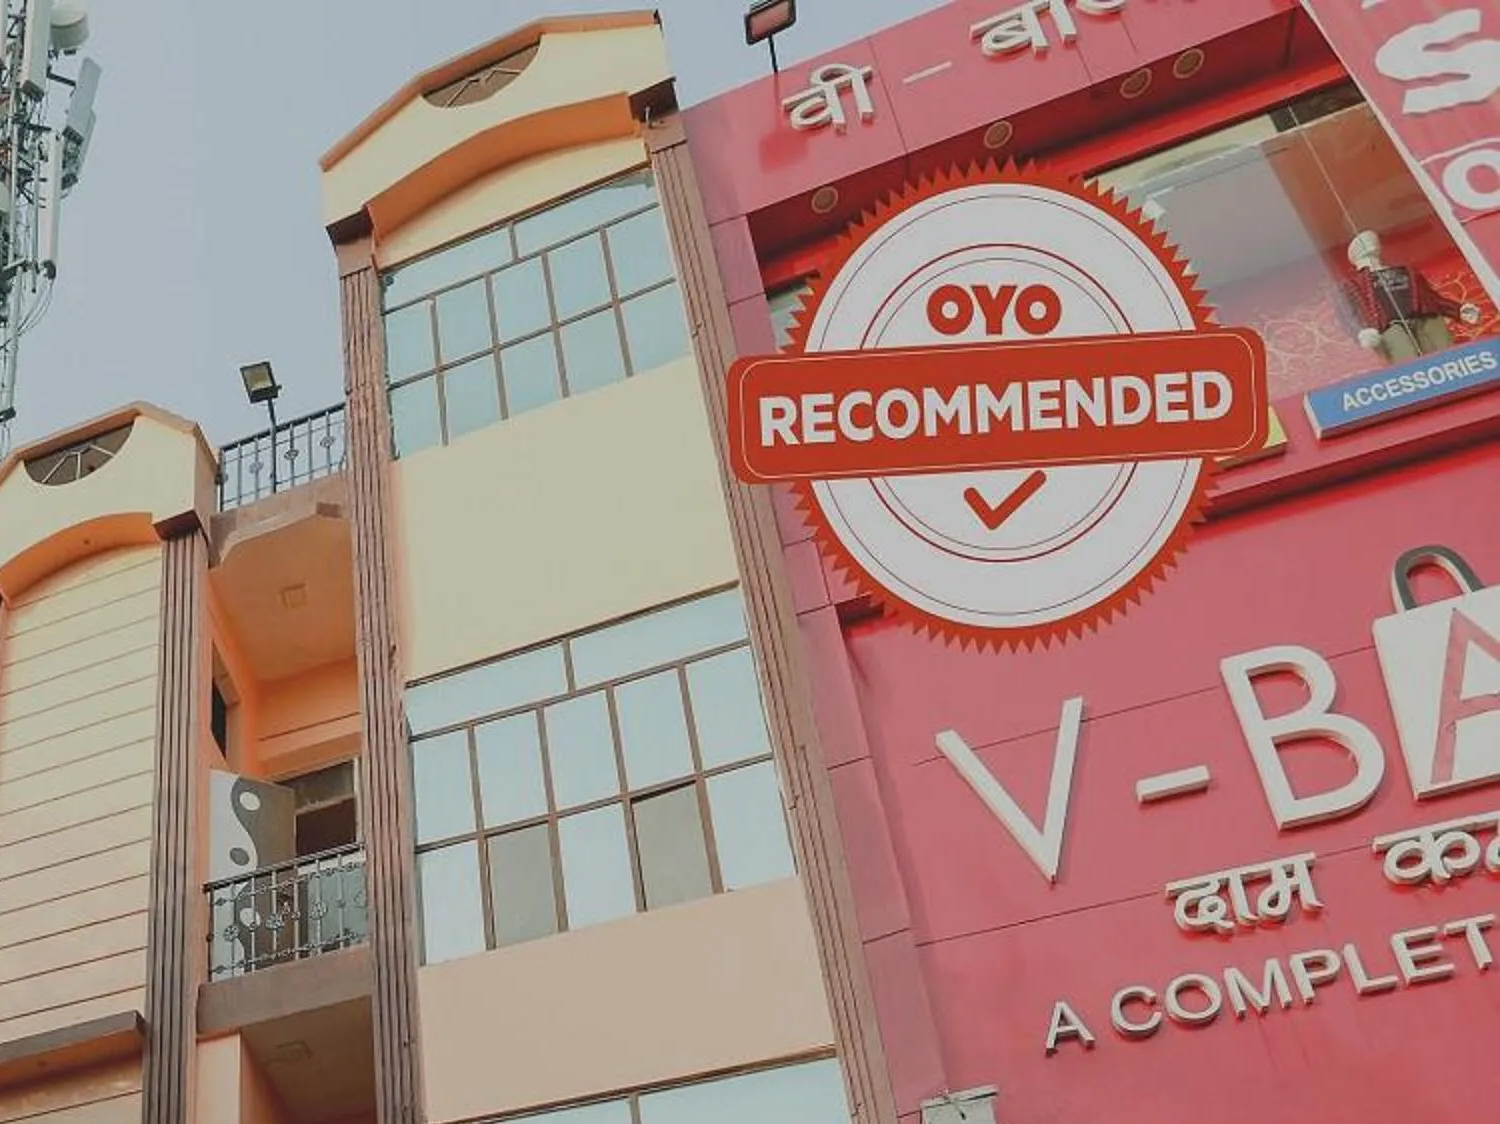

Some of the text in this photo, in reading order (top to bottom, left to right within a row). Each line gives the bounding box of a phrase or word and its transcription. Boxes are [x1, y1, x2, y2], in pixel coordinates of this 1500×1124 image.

[1342, 351, 1498, 411] ACCESSORIES
[1165, 852, 1325, 934] दाम
[1045, 913, 1497, 1056] A COMPLET
